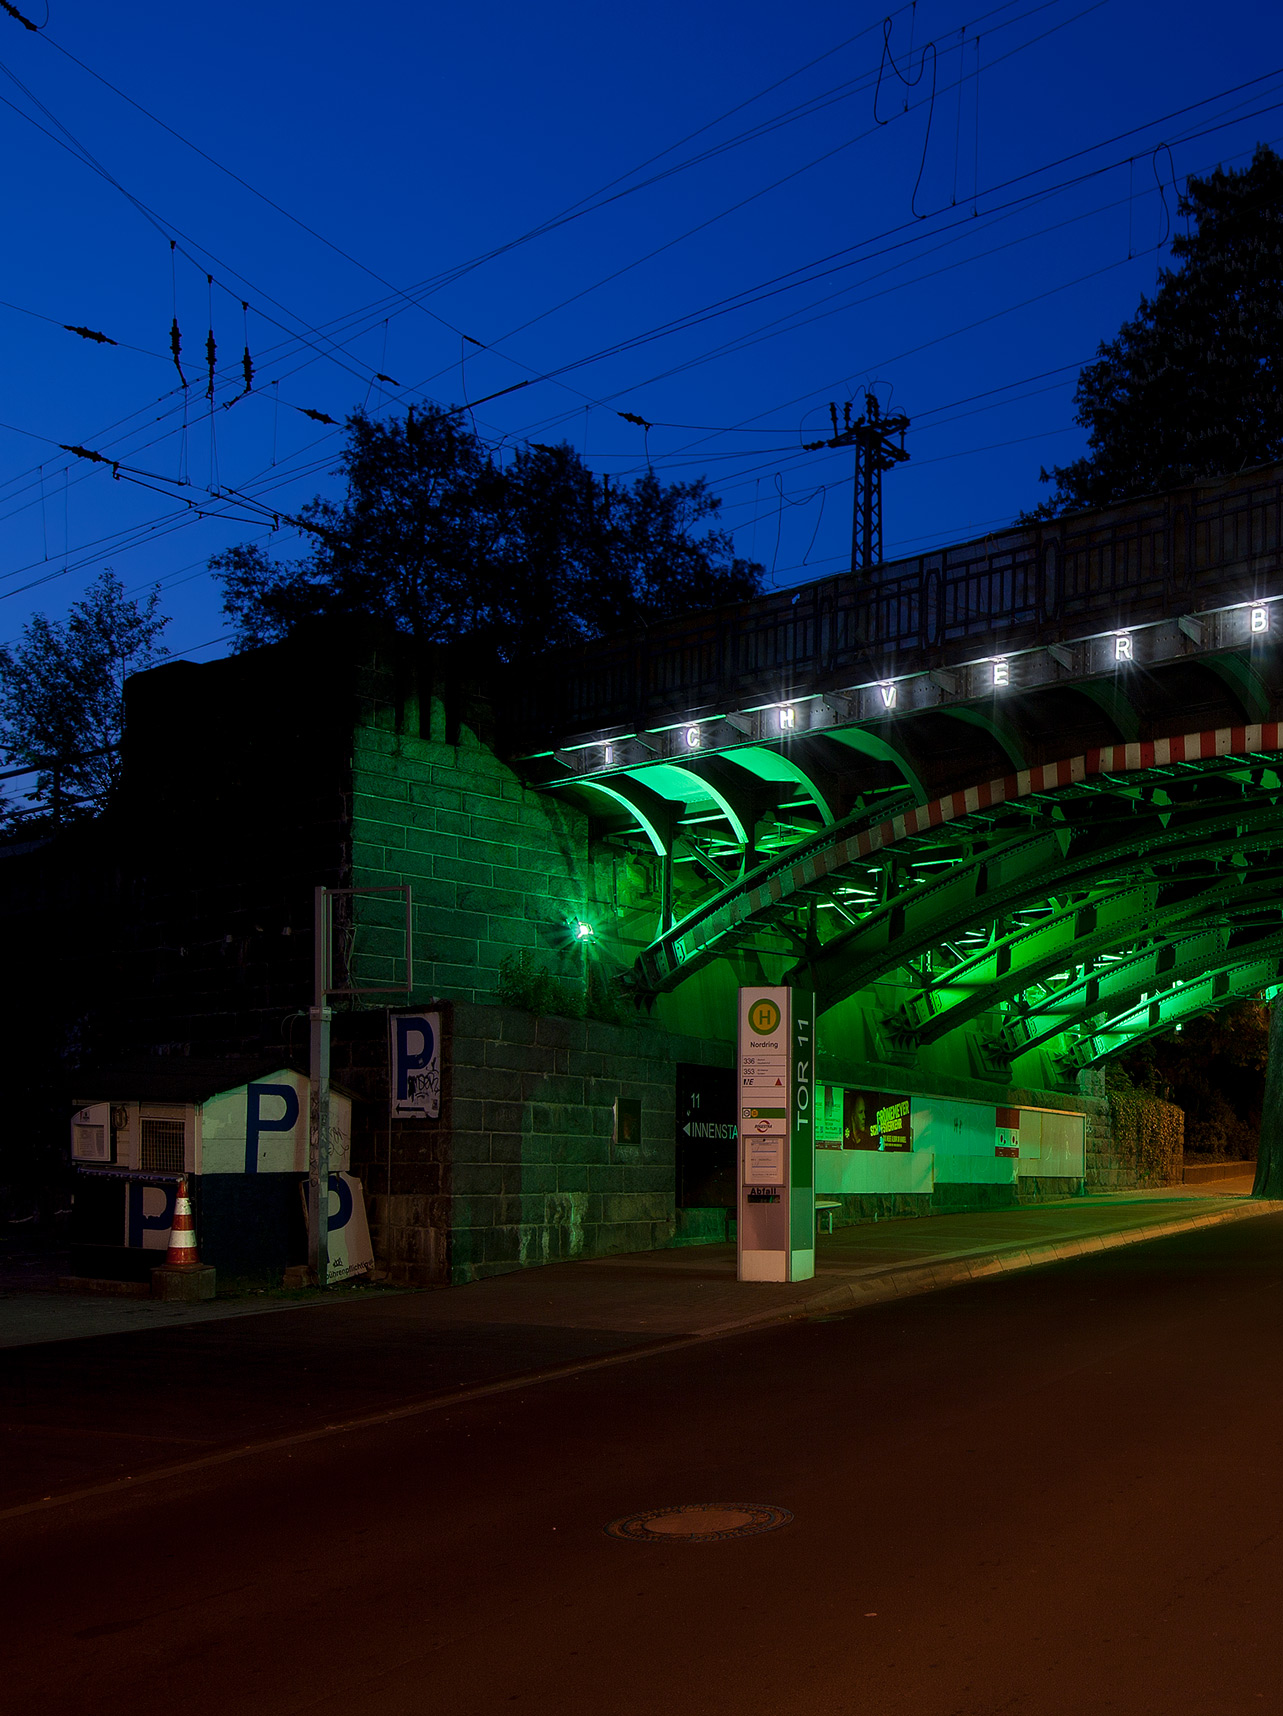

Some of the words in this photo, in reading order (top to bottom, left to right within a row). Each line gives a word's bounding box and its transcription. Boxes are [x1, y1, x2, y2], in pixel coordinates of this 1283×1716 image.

[759, 1010, 771, 1025] H
[797, 1019, 809, 1047] 11
[750, 1041, 779, 1050] Nordring
[396, 1017, 434, 1100] P
[743, 1068, 755, 1076] 353
[690, 1092, 701, 1109] 11
[797, 1061, 809, 1131] TOR
[245, 1083, 299, 1173] P
[750, 1187, 777, 1195] Abfall
[129, 1182, 178, 1248] P
